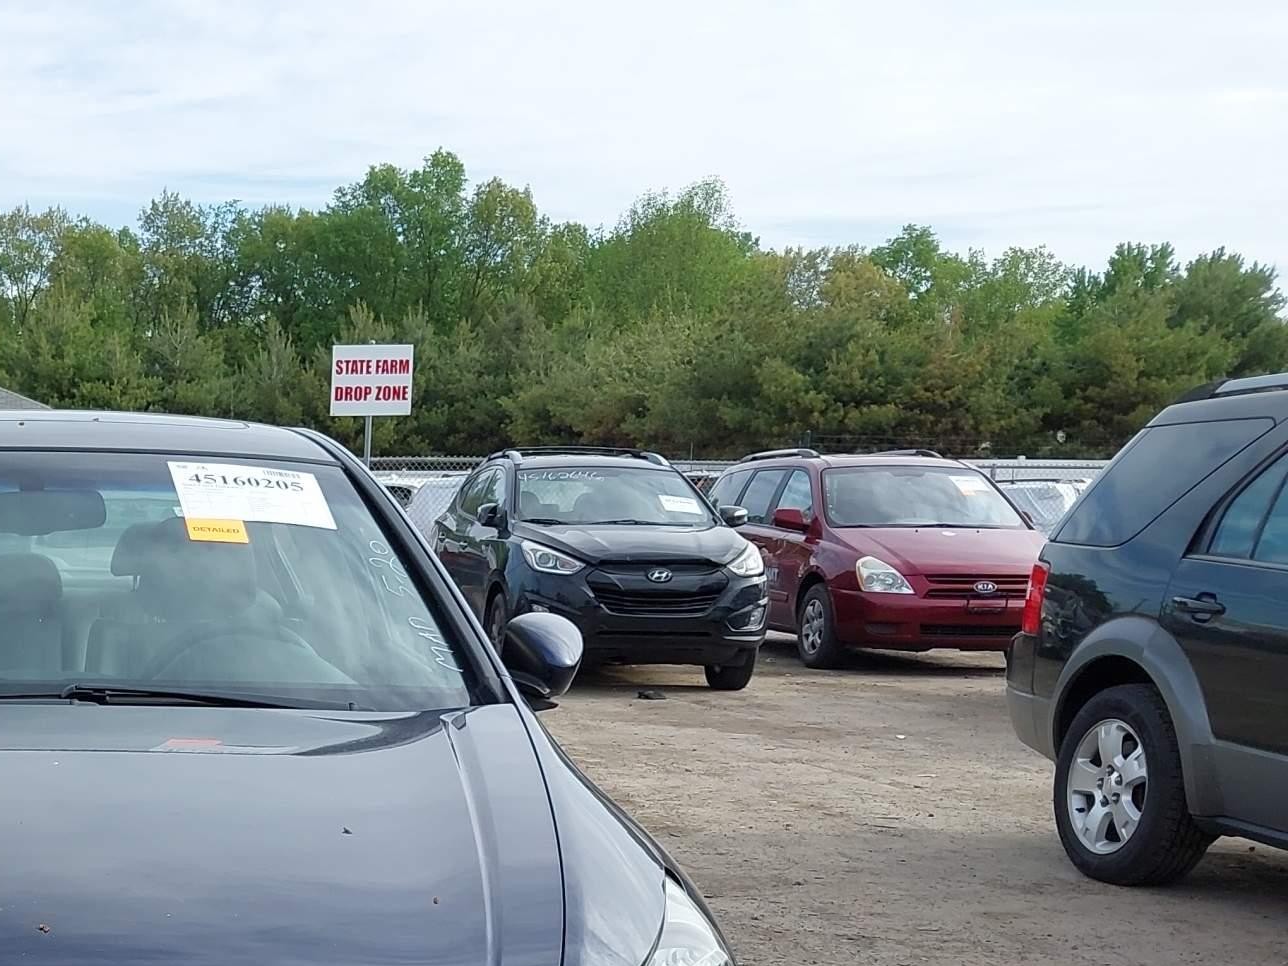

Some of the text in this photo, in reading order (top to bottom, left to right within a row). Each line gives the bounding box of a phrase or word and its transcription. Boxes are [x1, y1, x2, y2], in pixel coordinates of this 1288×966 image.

[335, 359, 410, 375] STATE FARM
[334, 385, 409, 401] DROP ZONE
[188, 473, 304, 492] 45160205
[192, 526, 240, 534] DETAILED
